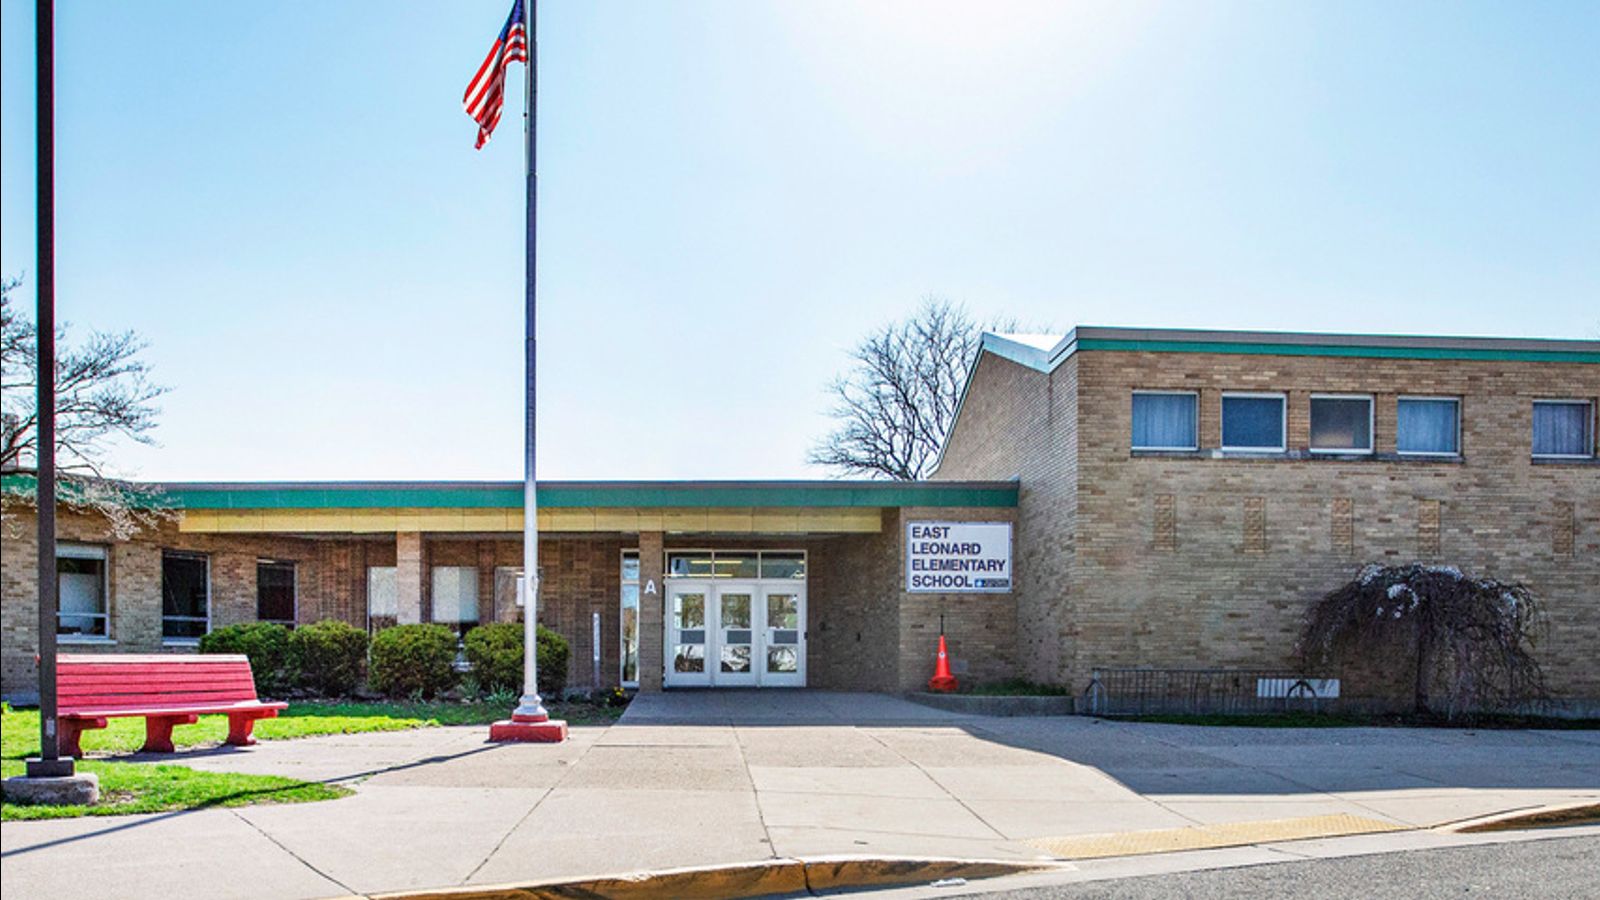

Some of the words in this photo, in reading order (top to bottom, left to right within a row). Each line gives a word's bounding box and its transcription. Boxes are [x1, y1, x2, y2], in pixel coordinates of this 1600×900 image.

[912, 527, 950, 538] EAST
[912, 543, 981, 554] LEONARD
[912, 559, 1006, 571] ELEMENTARY
[644, 579, 657, 594] A
[912, 575, 973, 587] SCHOOL
